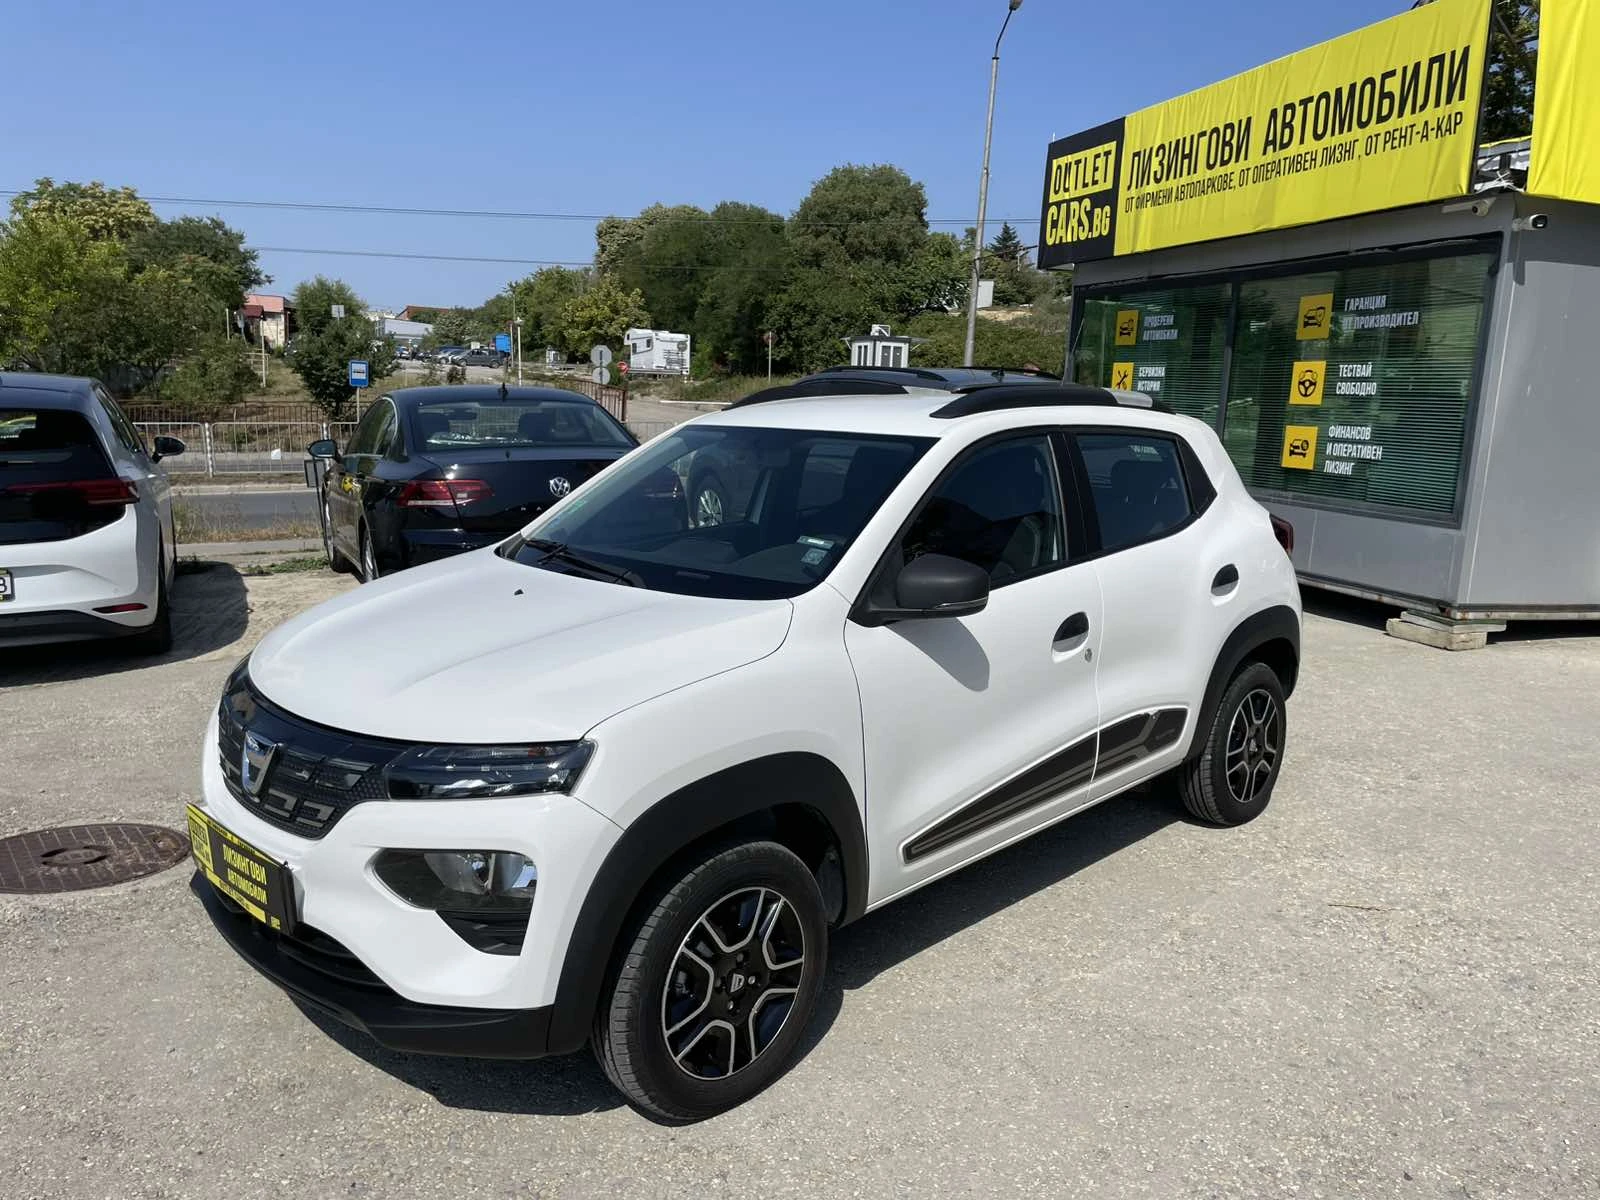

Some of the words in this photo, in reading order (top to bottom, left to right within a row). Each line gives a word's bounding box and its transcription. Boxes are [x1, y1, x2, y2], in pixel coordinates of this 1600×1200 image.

[1127, 116, 1252, 191] ЛИЗИНГОВИ
[1262, 45, 1470, 156] АВТОМОБИЛИ
[1124, 196, 1135, 213] ОТ
[1238, 167, 1251, 187] ОТ
[1252, 151, 1317, 184] ОПЕРАТИВЕН
[1365, 133, 1381, 156] ОТ
[1383, 111, 1464, 152] РЕНТ-А-КАР
[1053, 150, 1113, 195] OUTLET
[1046, 198, 1111, 246] CARS.BG
[1344, 295, 1386, 311] ГАРАНЦИЯ
[1354, 311, 1419, 329] ПРОИЗВОДИТЕЛ
[1339, 362, 1372, 377] ТЕСТВАЙ
[1336, 382, 1377, 396] СВОБОДНО
[1328, 425, 1371, 440] ФИНАНСОВ
[1326, 442, 1332, 456] И
[1333, 443, 1383, 460] ОПЕРАТИВЕН
[1324, 460, 1355, 475] ЛИЗИНГ
